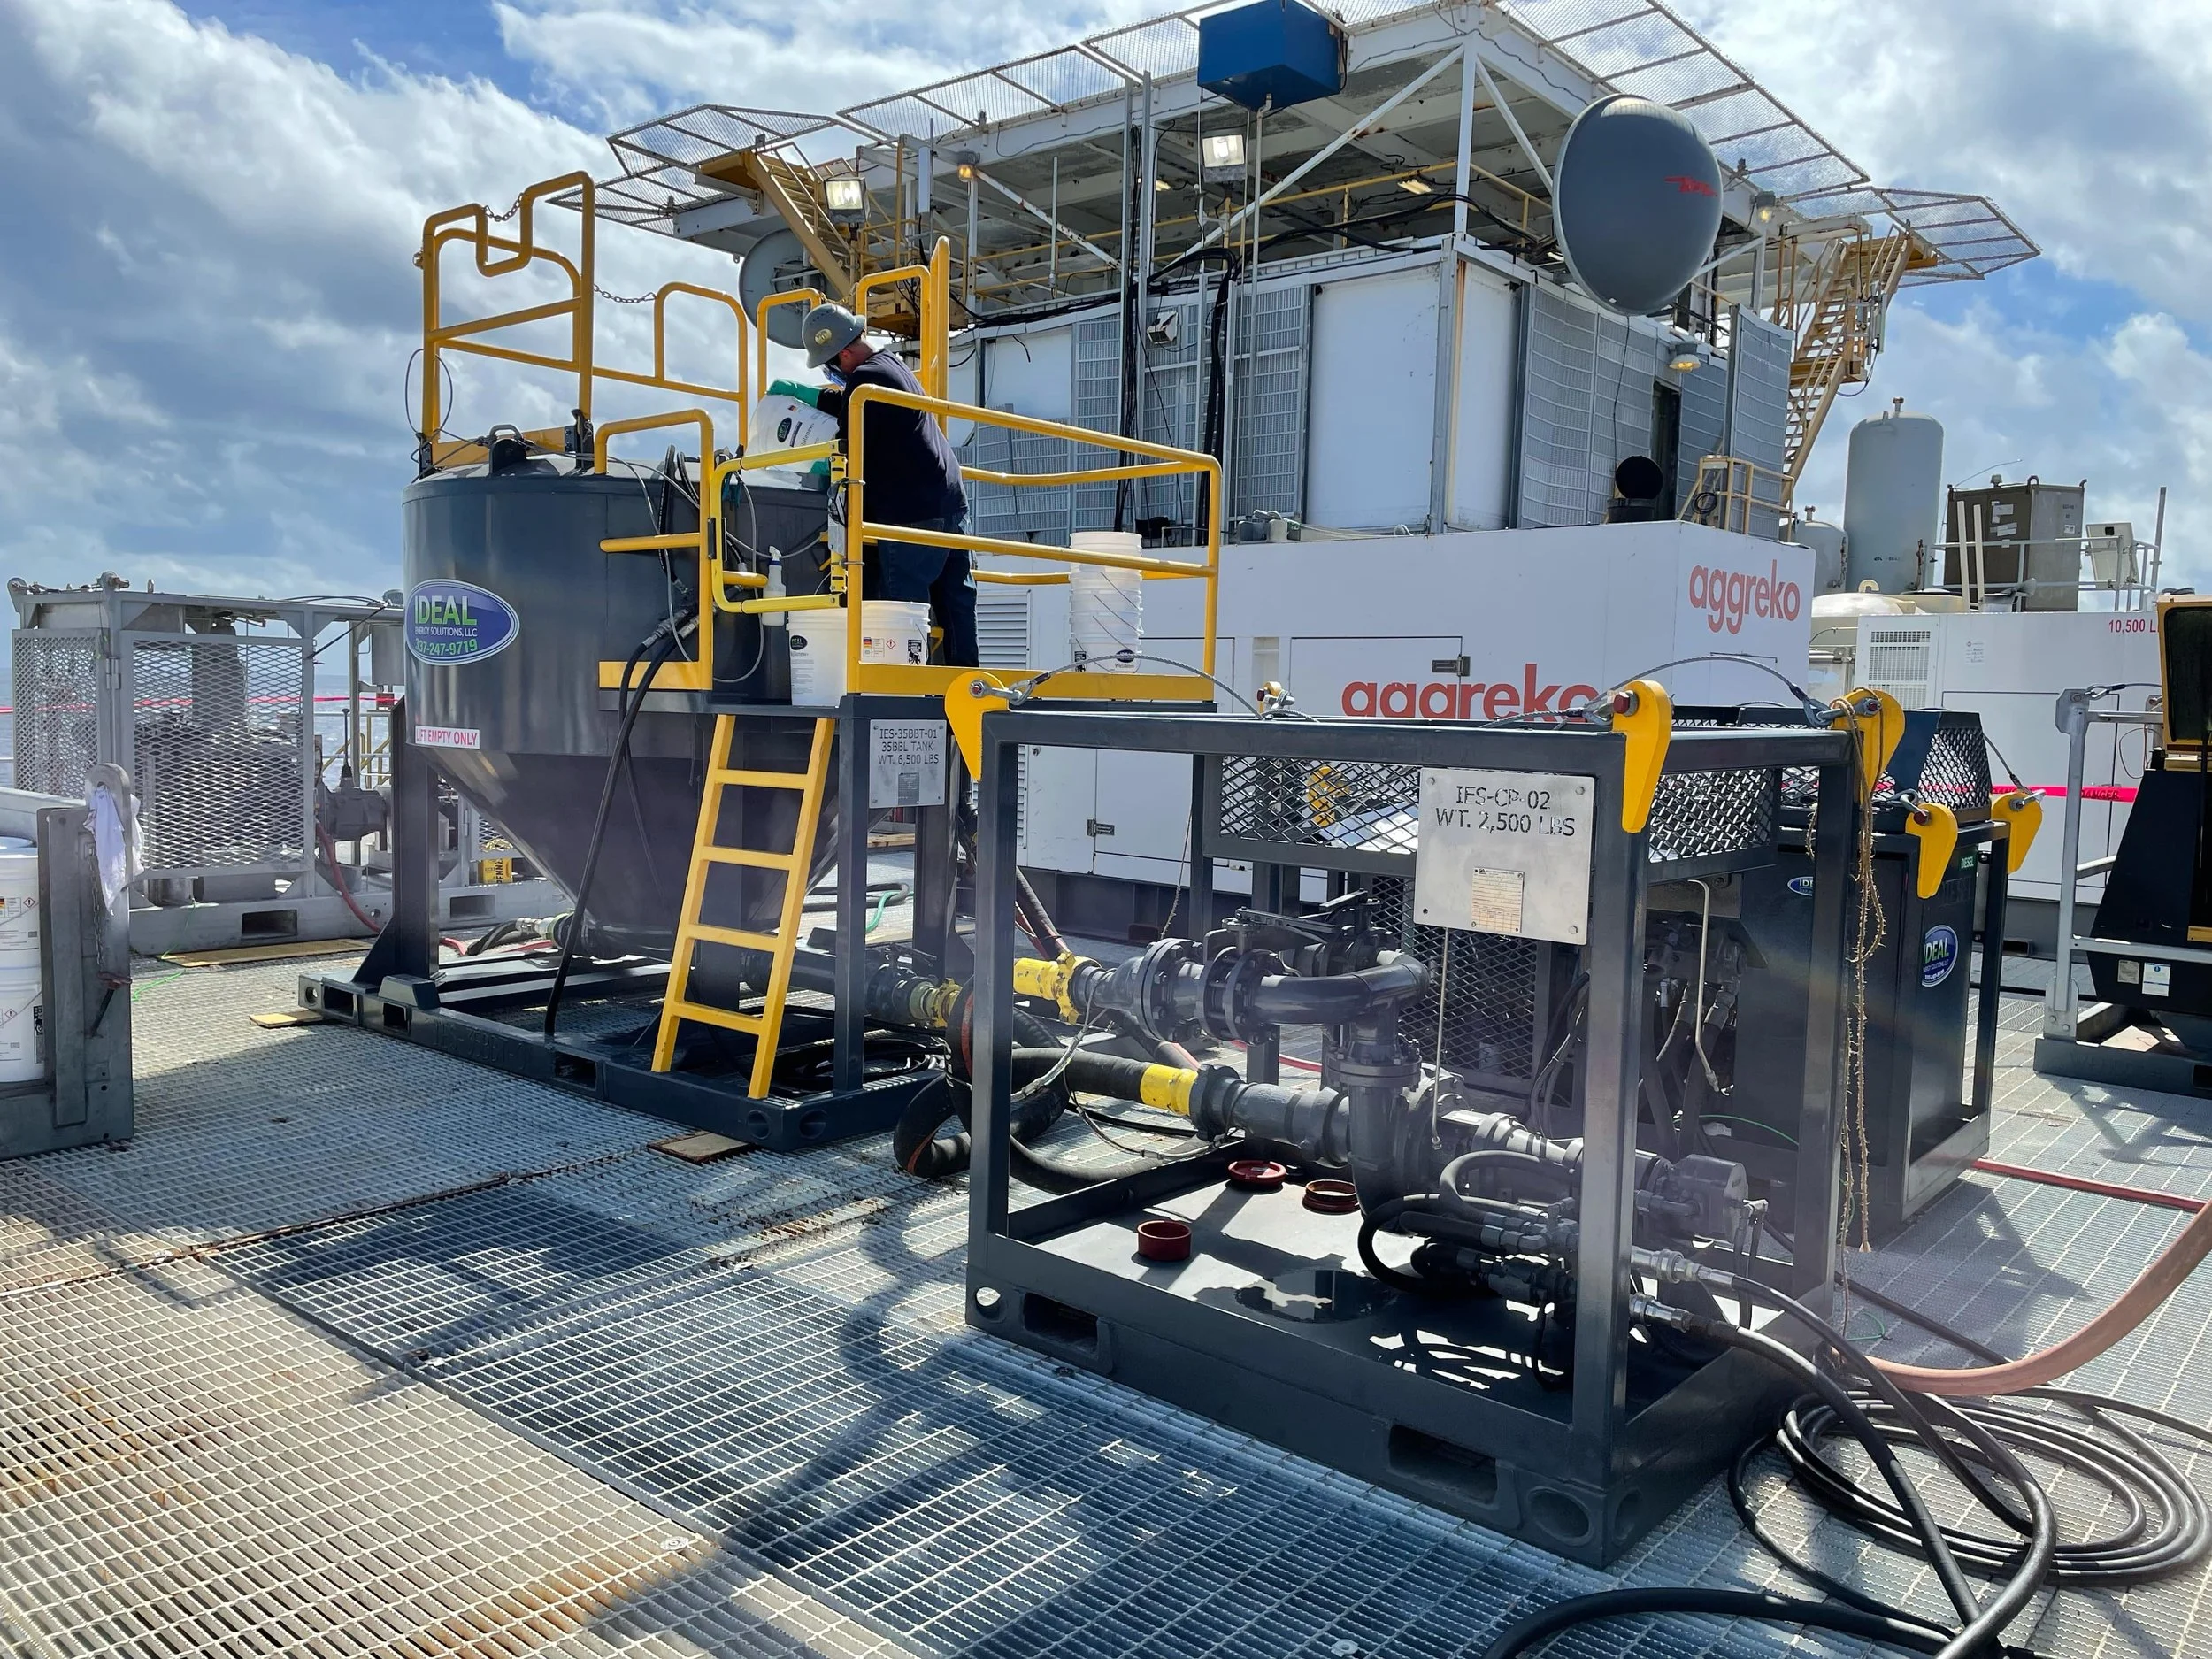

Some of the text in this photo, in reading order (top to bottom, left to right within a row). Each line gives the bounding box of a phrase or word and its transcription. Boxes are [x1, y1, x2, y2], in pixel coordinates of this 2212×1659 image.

[1689, 559, 1801, 634] aggreko
[414, 595, 478, 625] IDEAL
[414, 626, 478, 637] ENERGY SOLUTIONS, LLC
[2108, 618, 2159, 634] 10,500 L
[414, 638, 478, 656] 337-247-9719
[416, 728, 478, 746] LIFT EMPTY ONLY
[879, 728, 938, 739] IES-35BBT-01
[881, 741, 934, 752] 35BBL TANK
[878, 753, 940, 766] WT. 6,500 LBS
[1455, 785, 1551, 810] IES-CP-02
[1435, 807, 1576, 836] WT. 2,500 LBS
[1923, 937, 1949, 964] IDEAL
